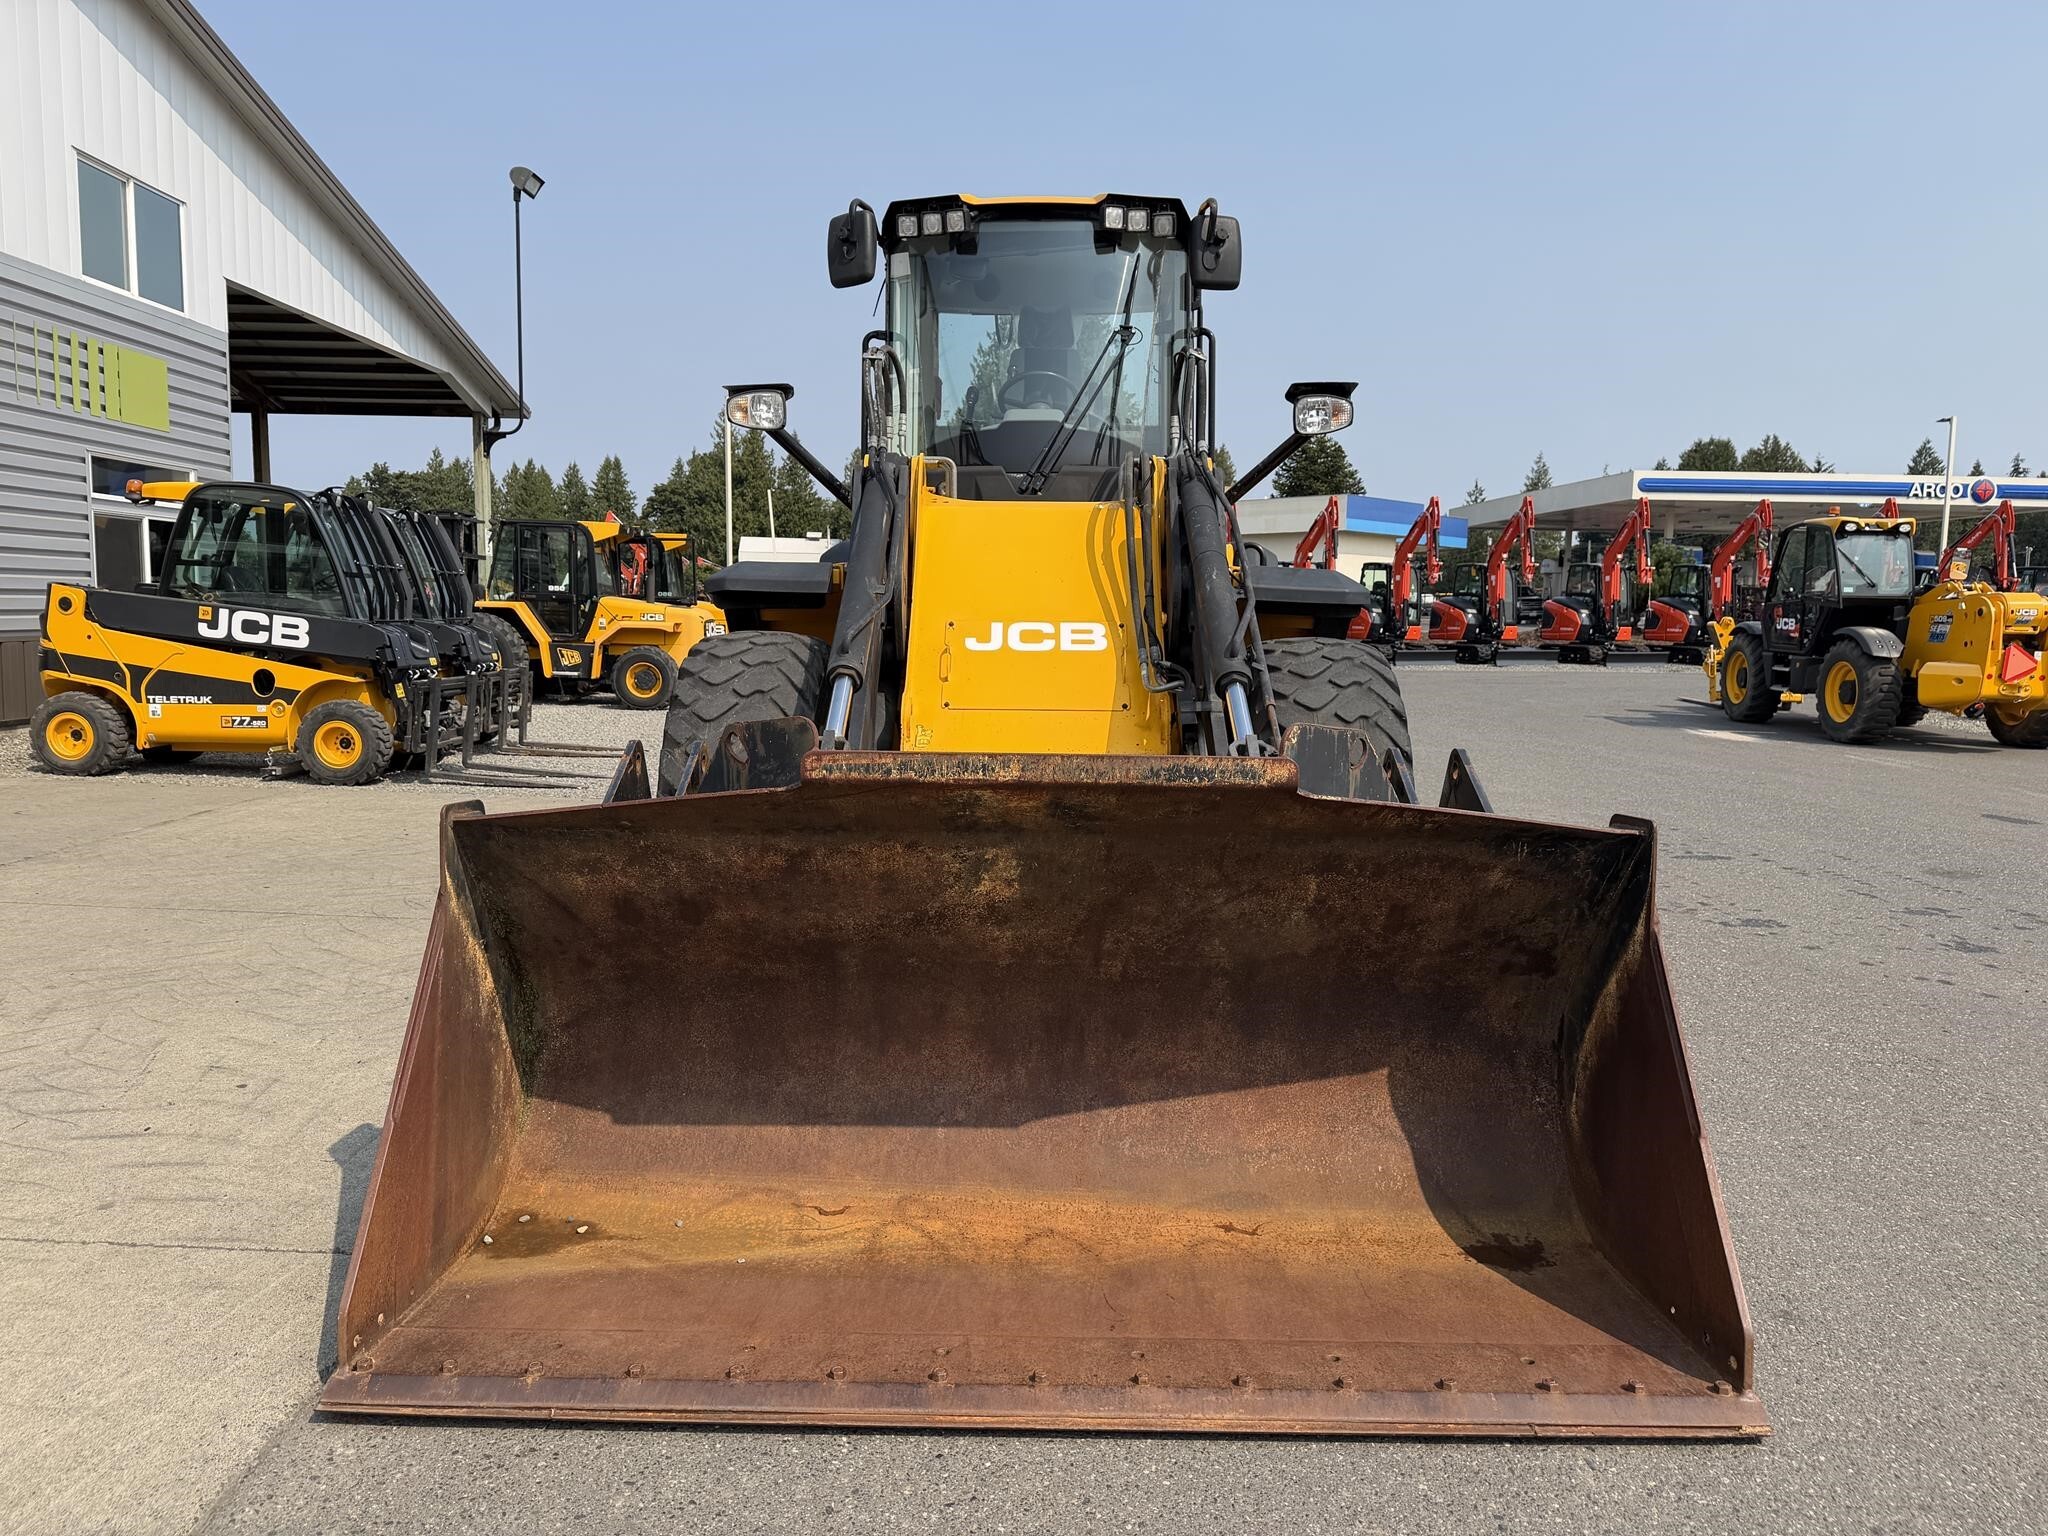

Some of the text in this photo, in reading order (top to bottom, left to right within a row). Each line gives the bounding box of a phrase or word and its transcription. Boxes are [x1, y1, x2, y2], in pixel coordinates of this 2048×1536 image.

[1908, 482, 1963, 499] ARCO
[640, 613, 665, 621] JCB
[2015, 608, 2039, 616] JCB
[197, 607, 310, 648] JCB
[705, 620, 726, 637] JCB
[1776, 617, 1796, 630] JCB
[964, 621, 1108, 651] JCB
[561, 650, 581, 666] JCB
[147, 695, 213, 704] TELETRUK
